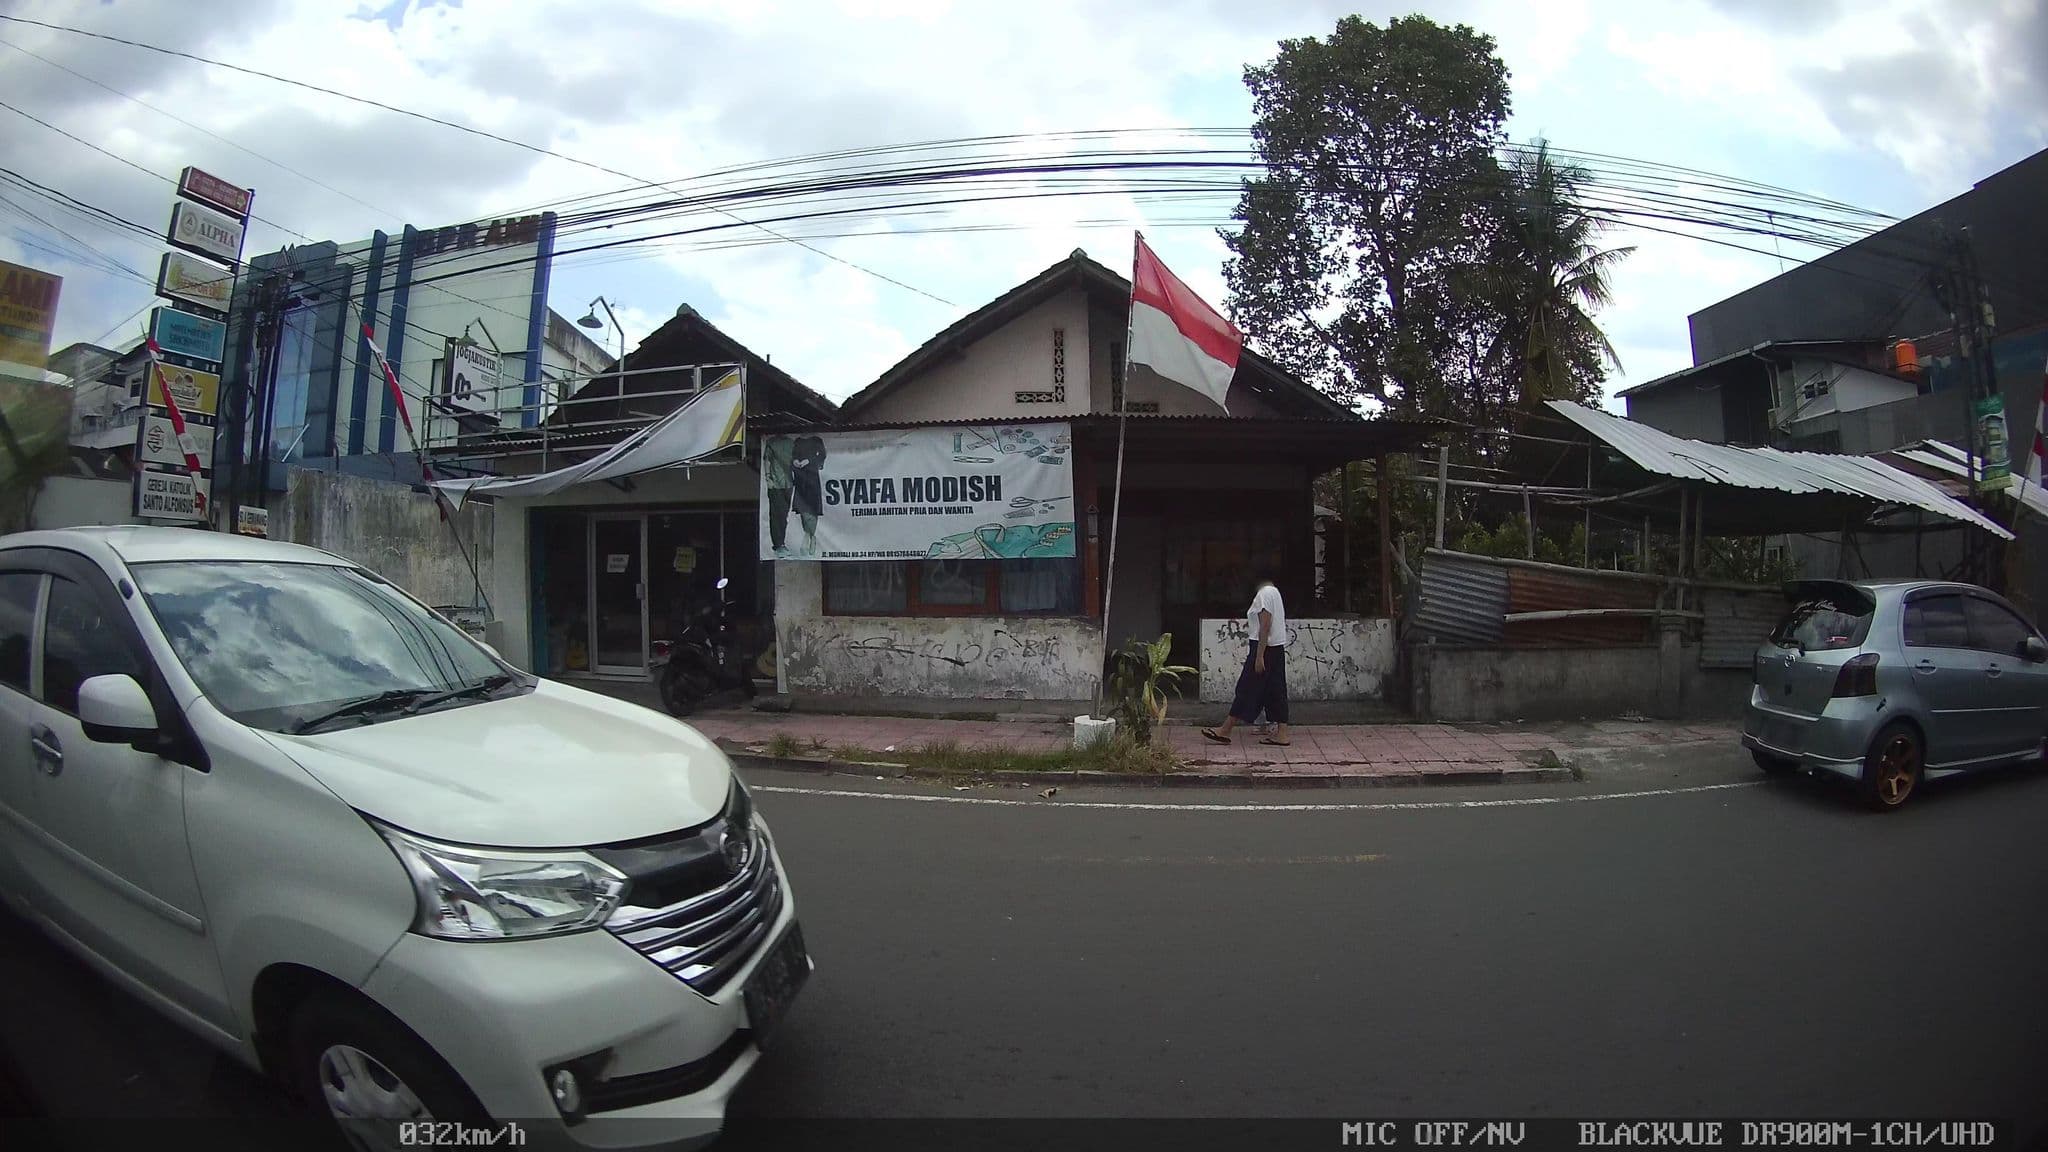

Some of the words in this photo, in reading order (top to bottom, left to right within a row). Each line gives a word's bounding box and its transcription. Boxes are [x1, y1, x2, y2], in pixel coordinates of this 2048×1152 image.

[199, 222, 236, 249] ALPHA
[147, 478, 168, 493] GEREJA
[169, 481, 192, 496] KATOLIK
[825, 477, 897, 505] SYAFA
[901, 475, 1002, 503] MODISH
[143, 494, 163, 511] SANTO
[163, 496, 194, 514] ALFONSUS
[851, 508, 878, 517] TERIMA
[879, 507, 909, 516] JAHITAN
[909, 506, 927, 516] PRIA
[928, 506, 944, 515] DAN
[944, 505, 974, 515] WANITA
